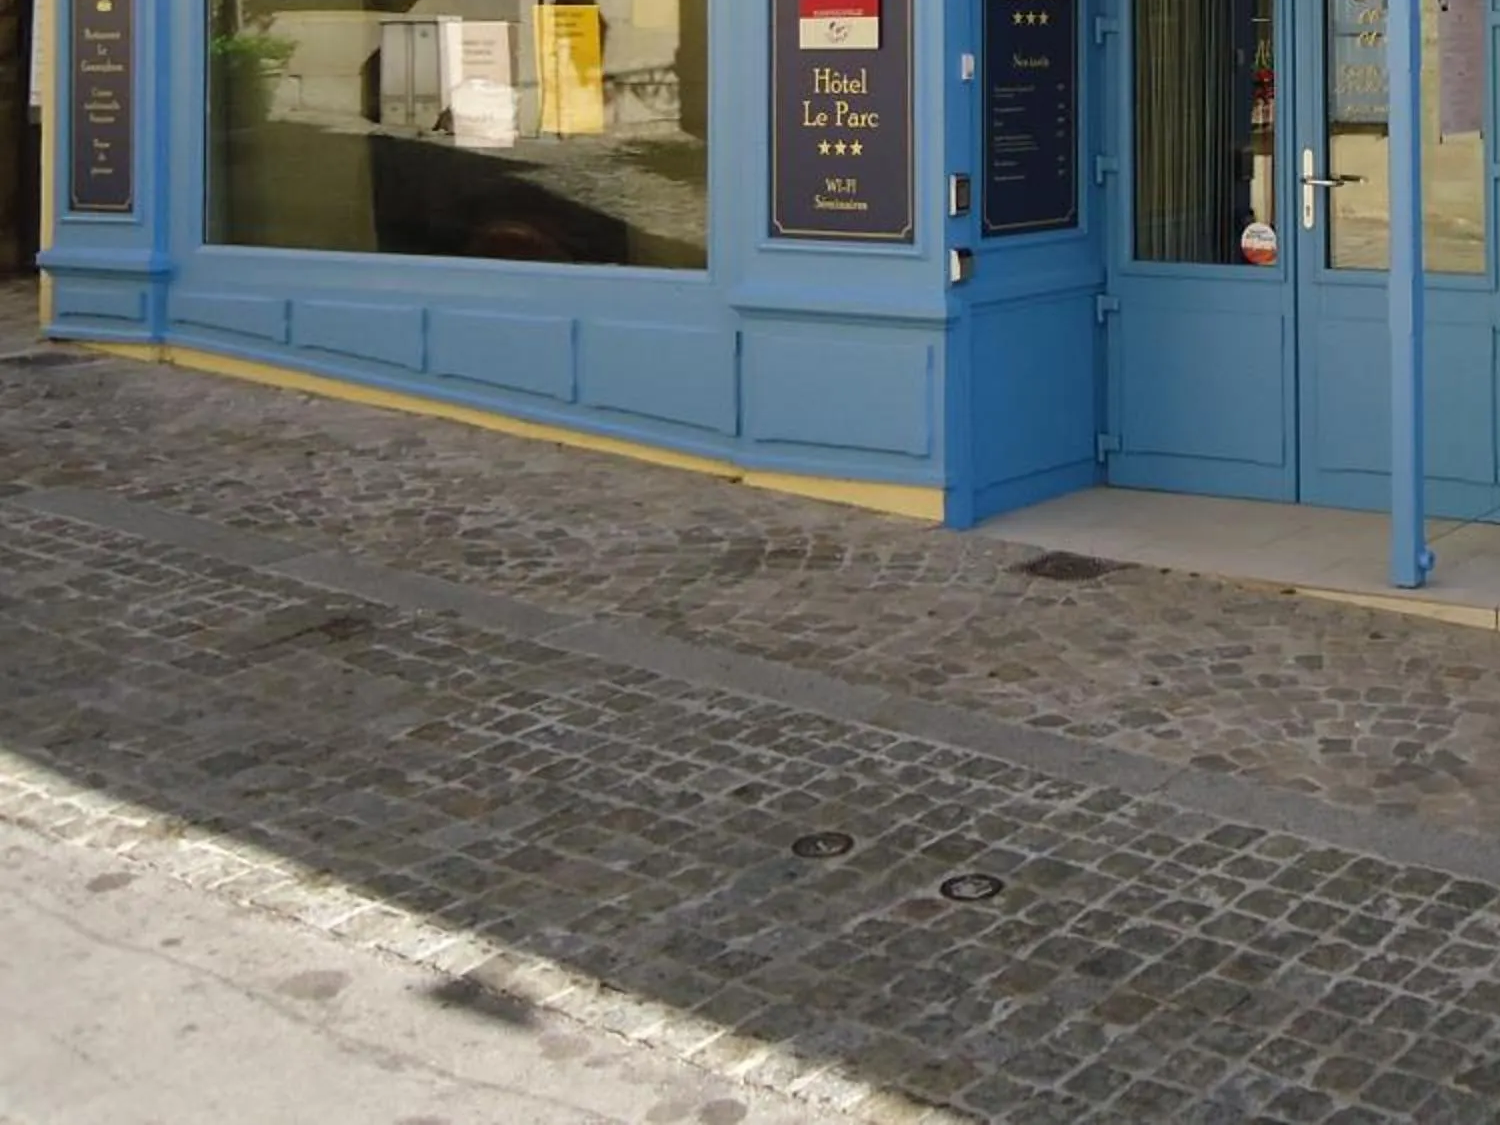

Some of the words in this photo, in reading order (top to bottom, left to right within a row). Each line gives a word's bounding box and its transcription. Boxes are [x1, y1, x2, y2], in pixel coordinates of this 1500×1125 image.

[813, 68, 868, 94] Hôtel
[802, 100, 828, 126] Le
[835, 100, 880, 128] Parc
